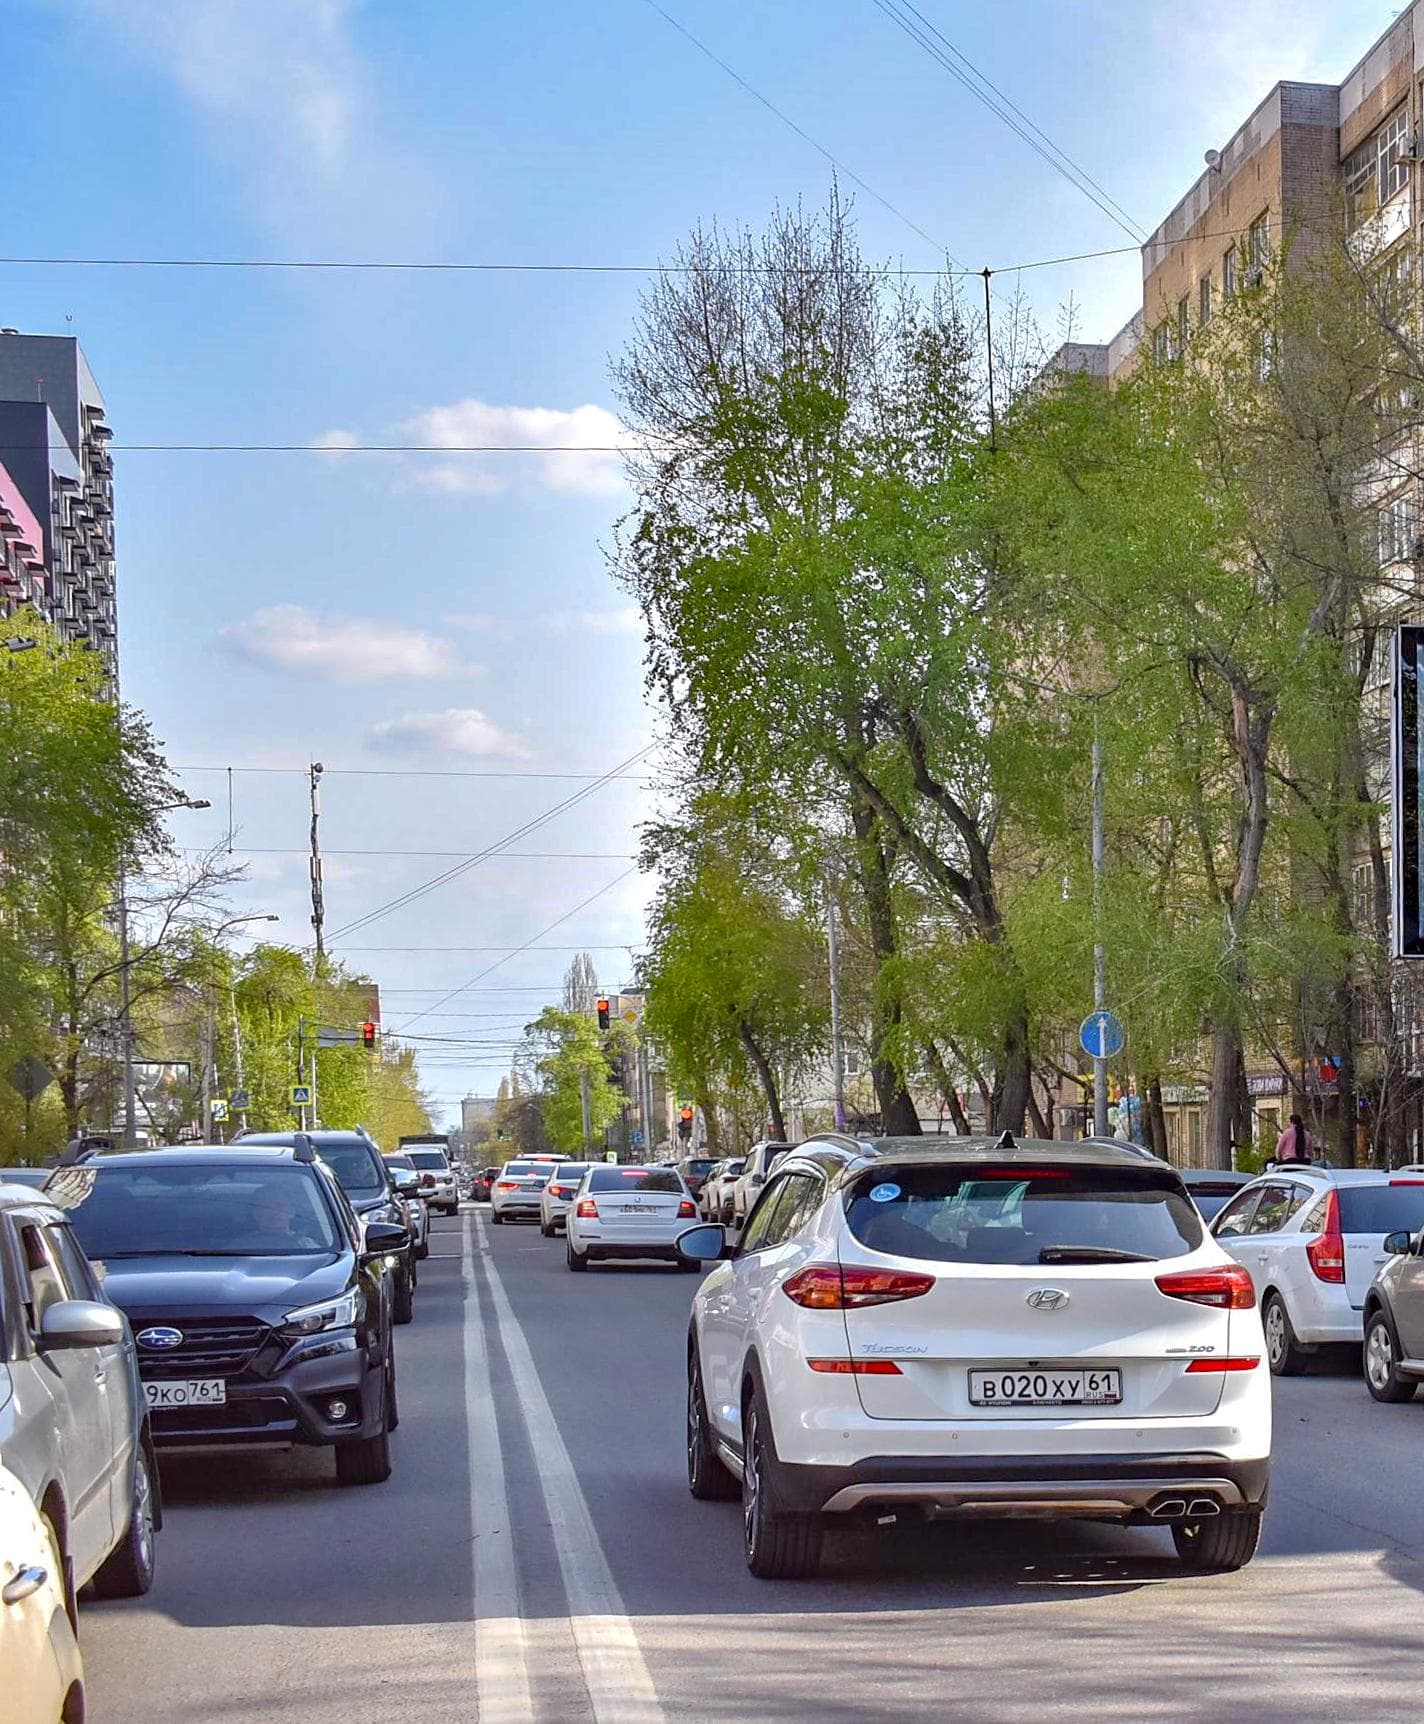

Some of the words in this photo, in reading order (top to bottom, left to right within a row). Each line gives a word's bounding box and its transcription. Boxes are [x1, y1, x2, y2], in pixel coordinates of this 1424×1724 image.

[146, 1385, 187, 1404] 9КО
[189, 1382, 220, 1397] 761
[983, 1375, 1080, 1399] В020ХУ
[1088, 1373, 1111, 1391] 61
